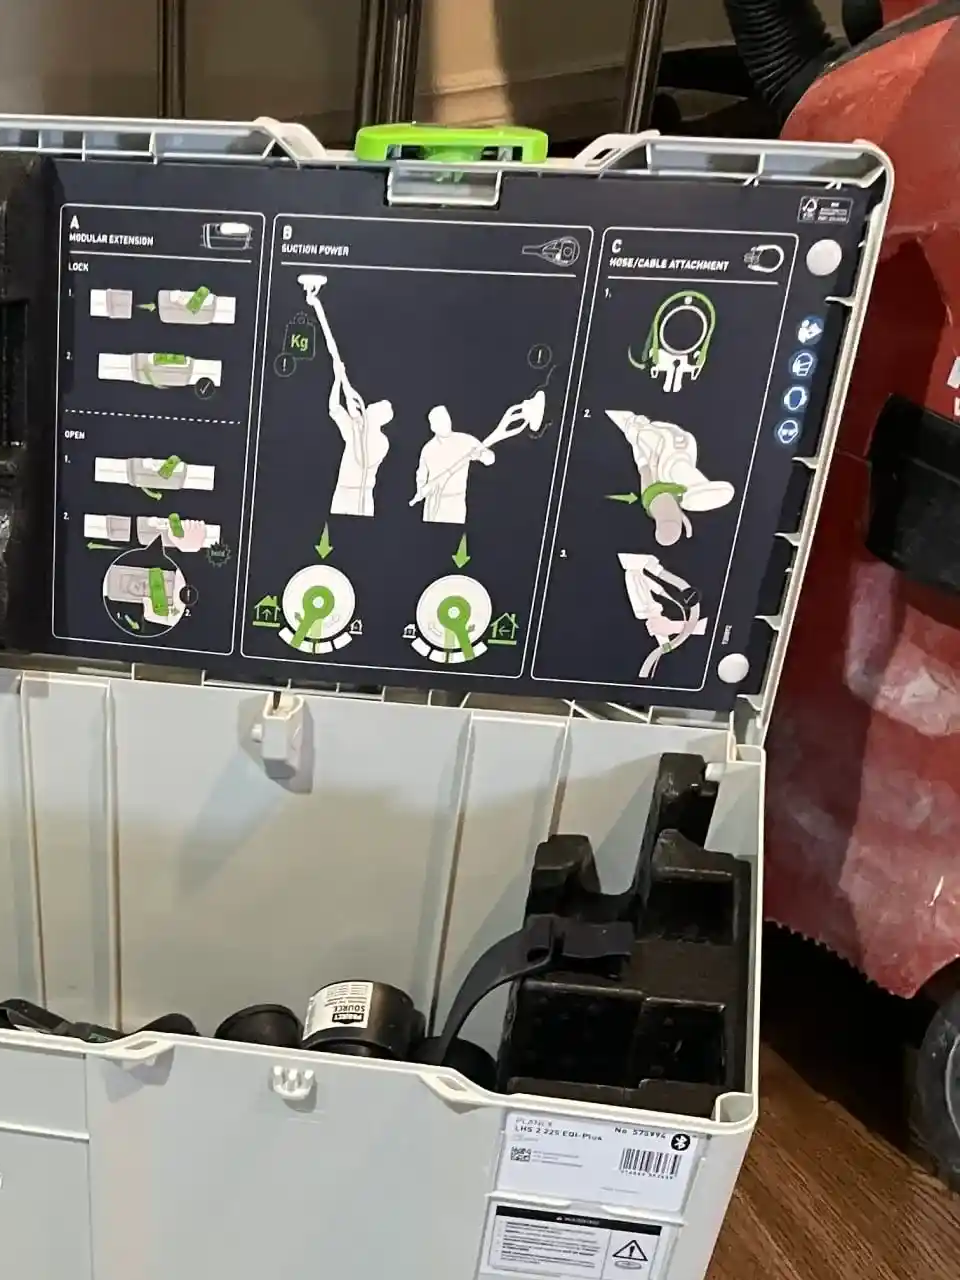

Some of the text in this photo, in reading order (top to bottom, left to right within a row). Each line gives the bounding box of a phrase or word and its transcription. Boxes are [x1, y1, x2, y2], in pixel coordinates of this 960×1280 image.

[70, 215, 79, 230] A
[69, 233, 154, 246] MODULAR EXTENSION
[282, 225, 292, 240] B
[281, 243, 350, 257] SUCTION POWER
[611, 239, 623, 254] C
[68, 262, 89, 272] LOCK
[609, 256, 730, 272] HOSE/CABLE ATTACHMENT
[291, 333, 309, 351] Kg
[64, 430, 85, 440] OPEN
[334, 1004, 366, 1012] SOURCE
[515, 1125, 534, 1133] LHS
[543, 1128, 560, 1136] 225
